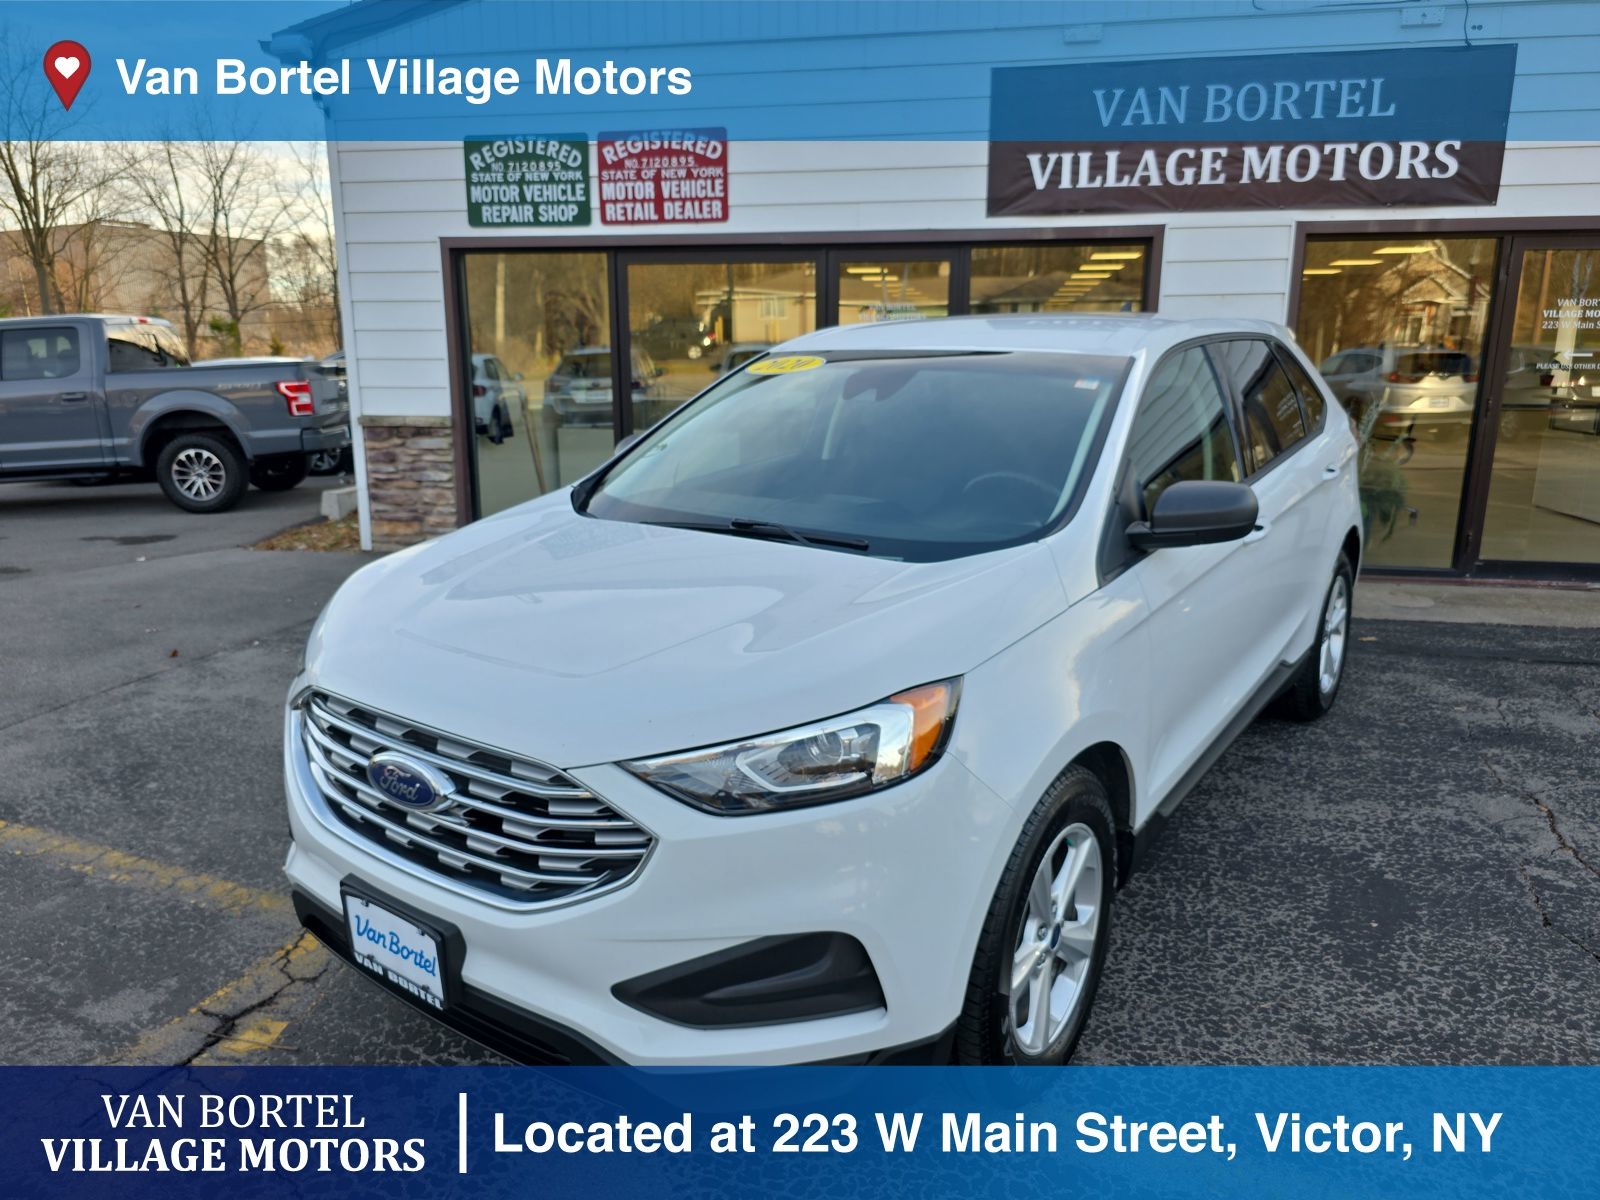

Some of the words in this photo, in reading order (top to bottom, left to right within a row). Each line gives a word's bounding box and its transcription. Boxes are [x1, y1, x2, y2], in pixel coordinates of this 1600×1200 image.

[1092, 85, 1191, 128] VAN
[1203, 78, 1397, 124] BORTEL
[469, 136, 582, 171] REGISTERED
[602, 131, 723, 165] REGISTERED
[507, 161, 561, 172] 7120895
[642, 156, 696, 168] 7120895
[1025, 147, 1228, 190] VILLAGE
[1239, 140, 1462, 185] MOTORS
[471, 172, 504, 183] STATE
[507, 172, 522, 182] OF
[525, 171, 549, 182] NEW
[552, 170, 583, 181] YORK
[601, 170, 637, 181] STATE
[641, 169, 657, 179] OF
[661, 168, 687, 178] NEW
[691, 167, 723, 178] YORK
[470, 185, 520, 203] MOTOR
[523, 184, 586, 202] VEHICLE
[601, 181, 655, 200] MOTOR
[661, 179, 724, 199] VEHICLE
[482, 205, 534, 223] REPAIR
[538, 204, 579, 223] SHOP
[605, 202, 659, 221] RETAIL
[663, 200, 723, 220] DEALER
[1557, 298, 1576, 307] VAN
[1543, 309, 1583, 318] VILLAGE
[1542, 321, 1559, 329] 223
[380, 765, 421, 801] Ford
[355, 914, 387, 949] Van
[388, 931, 437, 977] Bortel
